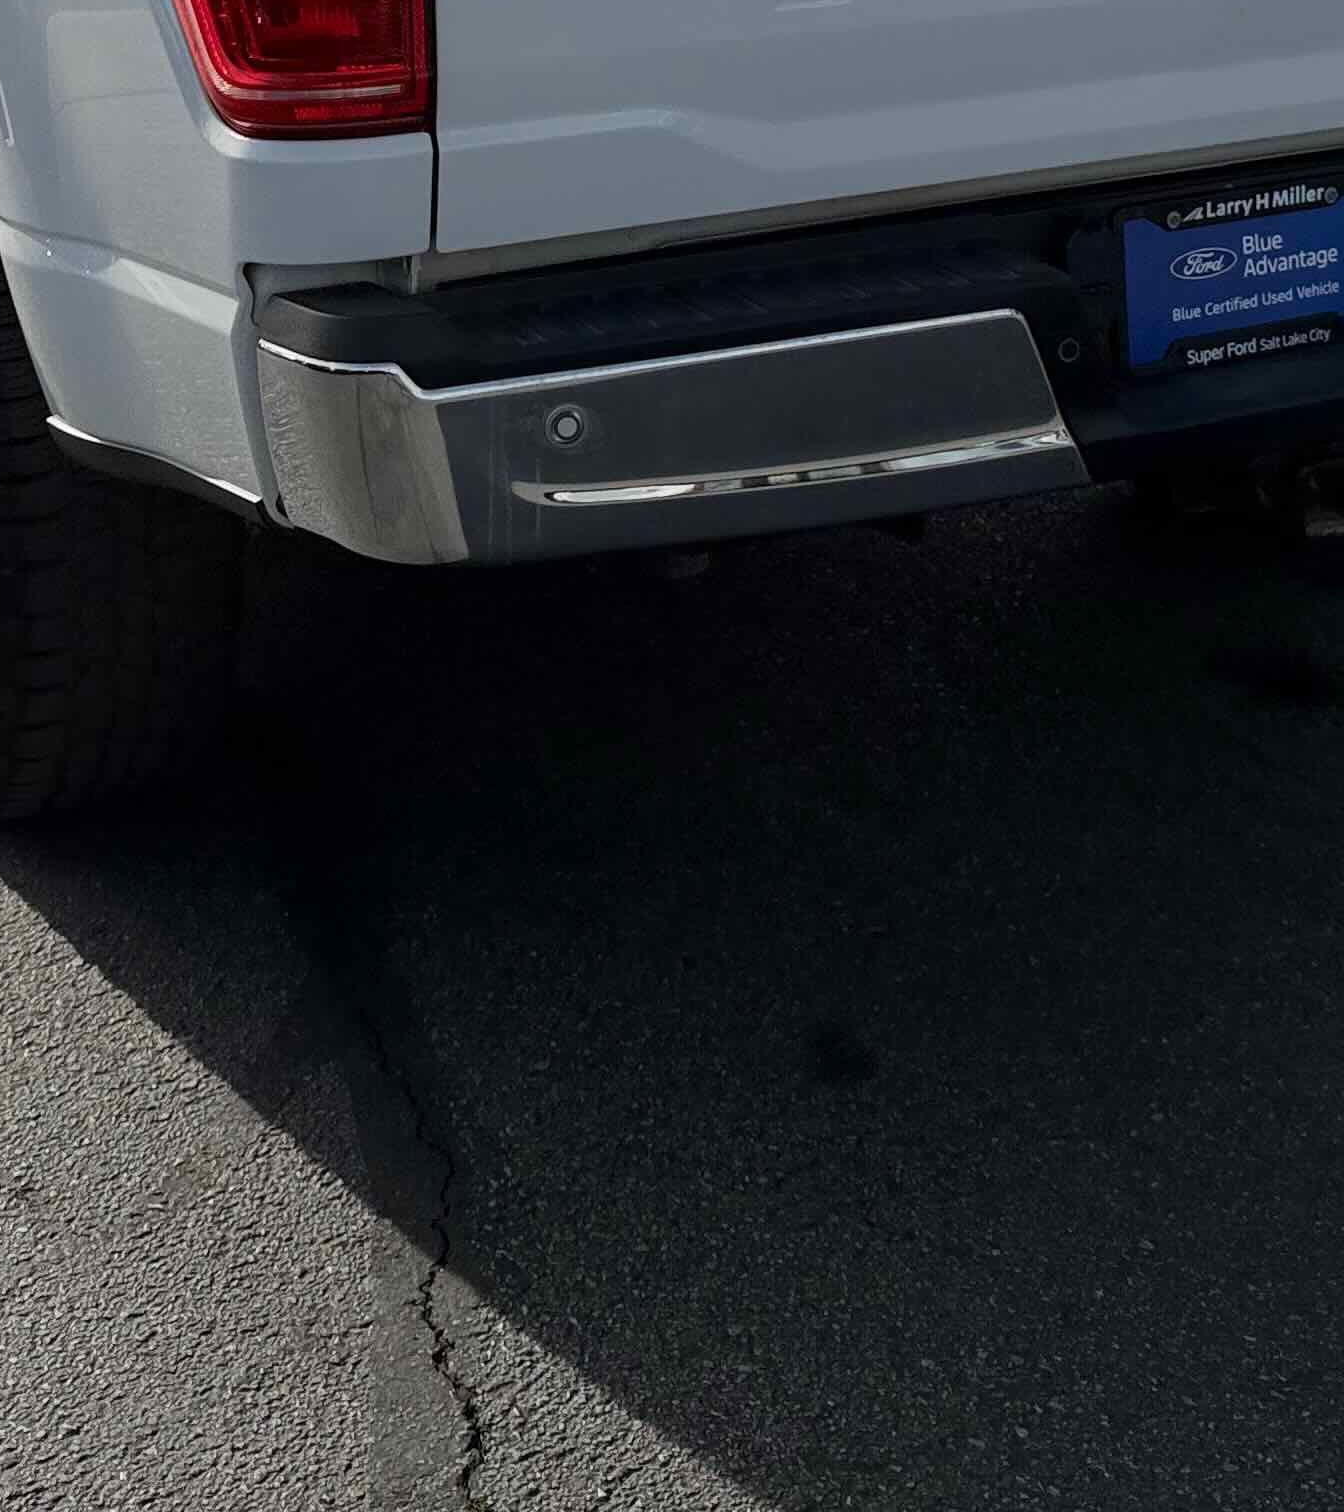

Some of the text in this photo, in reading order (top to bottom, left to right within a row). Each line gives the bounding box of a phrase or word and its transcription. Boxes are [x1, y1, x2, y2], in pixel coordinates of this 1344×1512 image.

[1206, 184, 1325, 218] Larry H Miller
[1242, 233, 1283, 255] Blue
[1183, 251, 1226, 276] Ford
[1243, 247, 1339, 278] Advantage
[1172, 281, 1340, 322] Blue Certified Used Vehicle
[1187, 327, 1331, 365] Super Ford Salt Lake City
